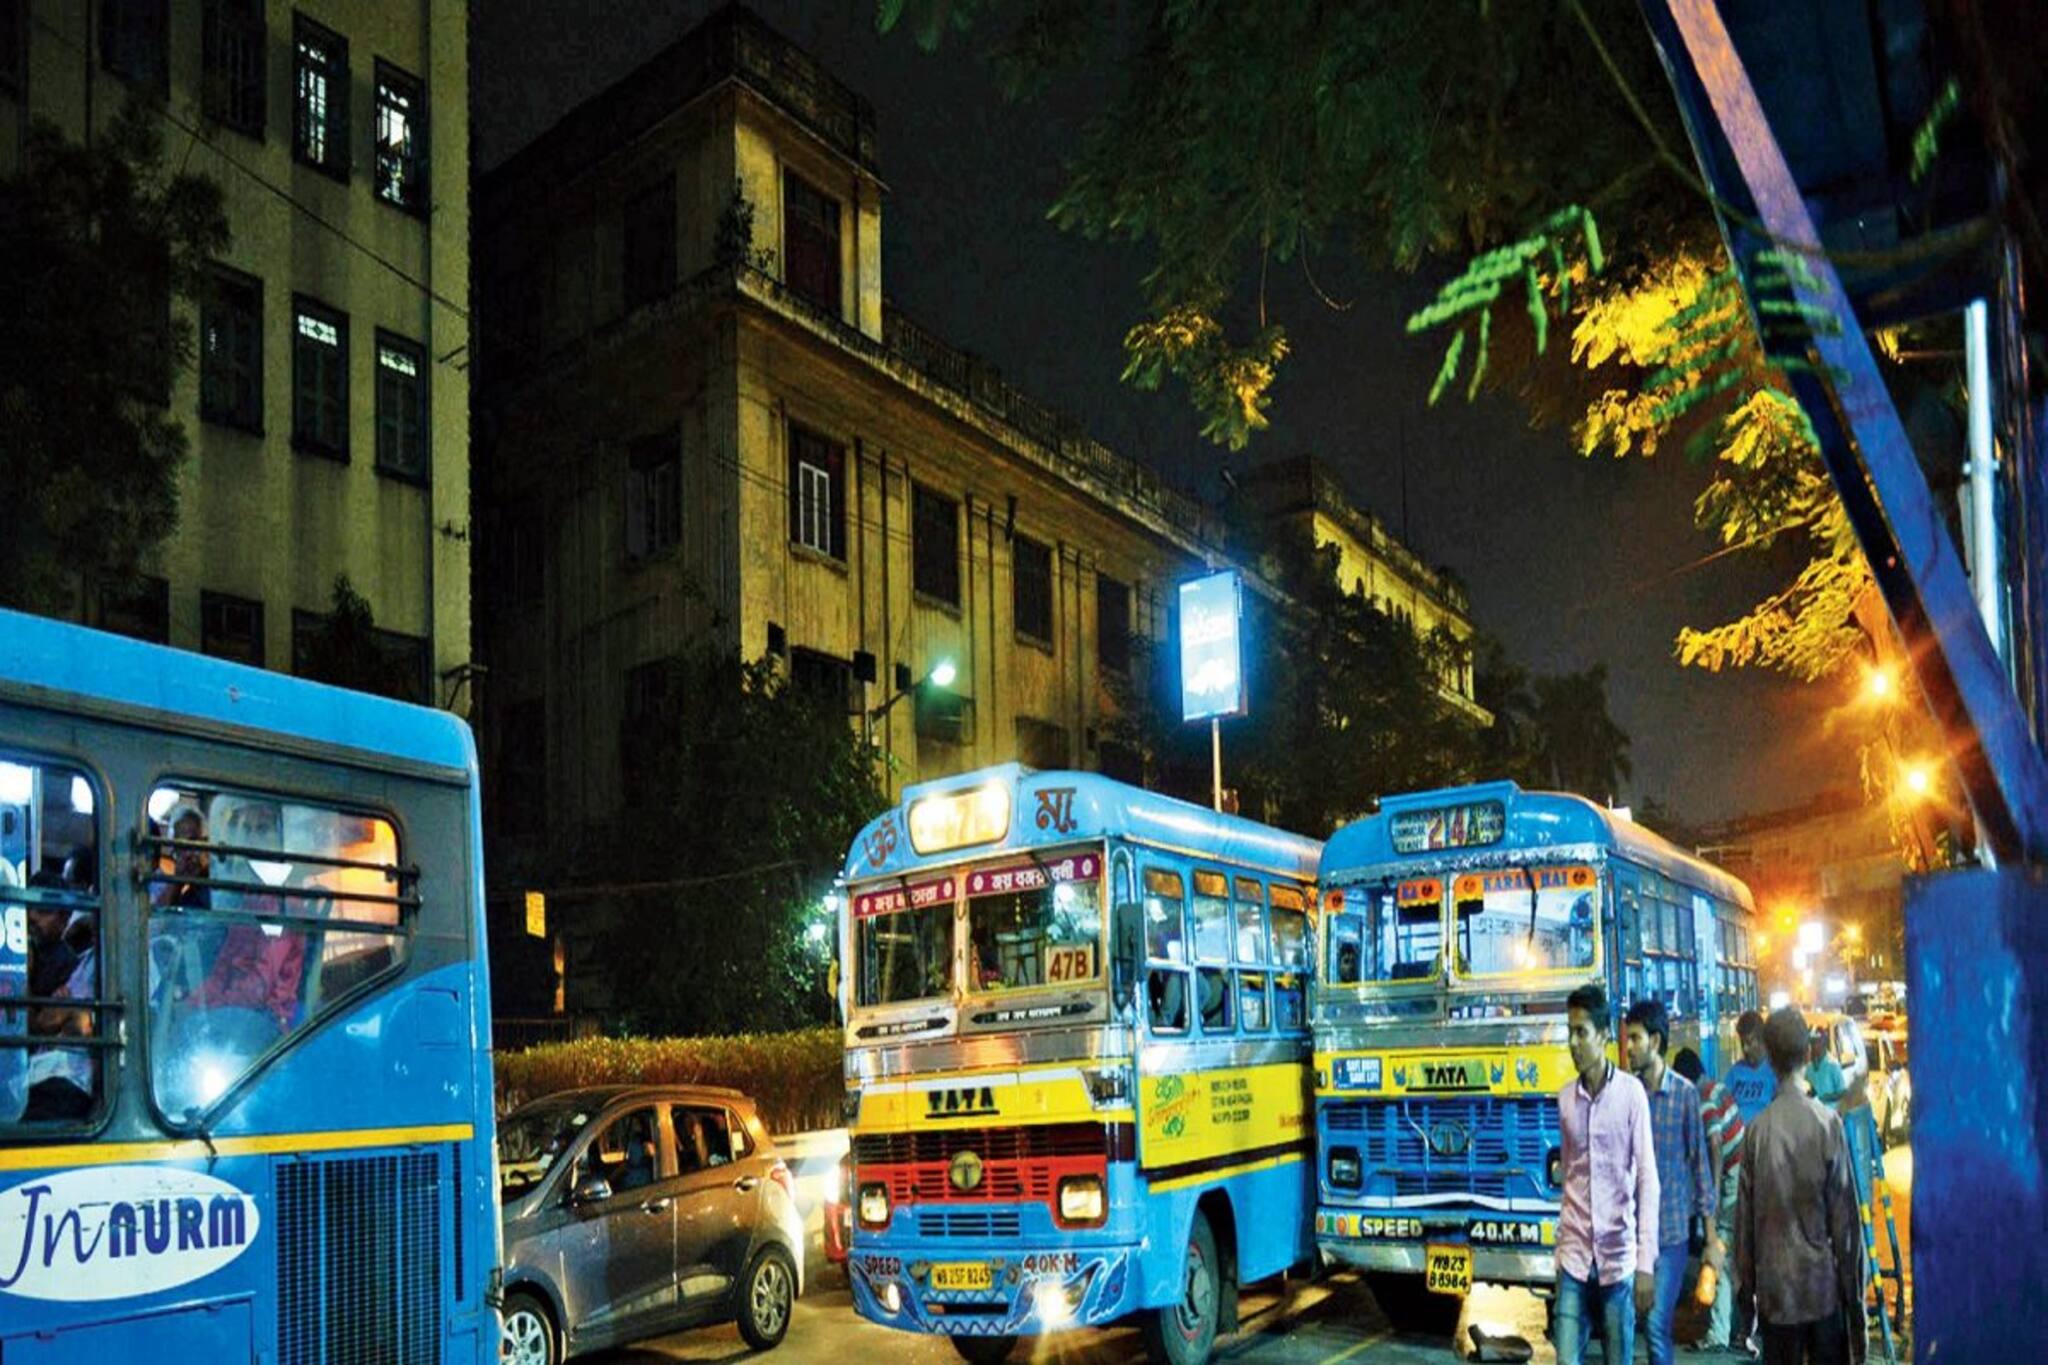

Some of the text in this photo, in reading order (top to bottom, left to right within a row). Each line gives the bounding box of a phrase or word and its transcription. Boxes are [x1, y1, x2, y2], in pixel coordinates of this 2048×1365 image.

[1050, 951, 1087, 980] 47B
[1424, 1066, 1468, 1085] TATA
[928, 1086, 994, 1110] TATA
[1362, 1217, 1424, 1238] SPEED
[864, 1256, 901, 1275] SPEED
